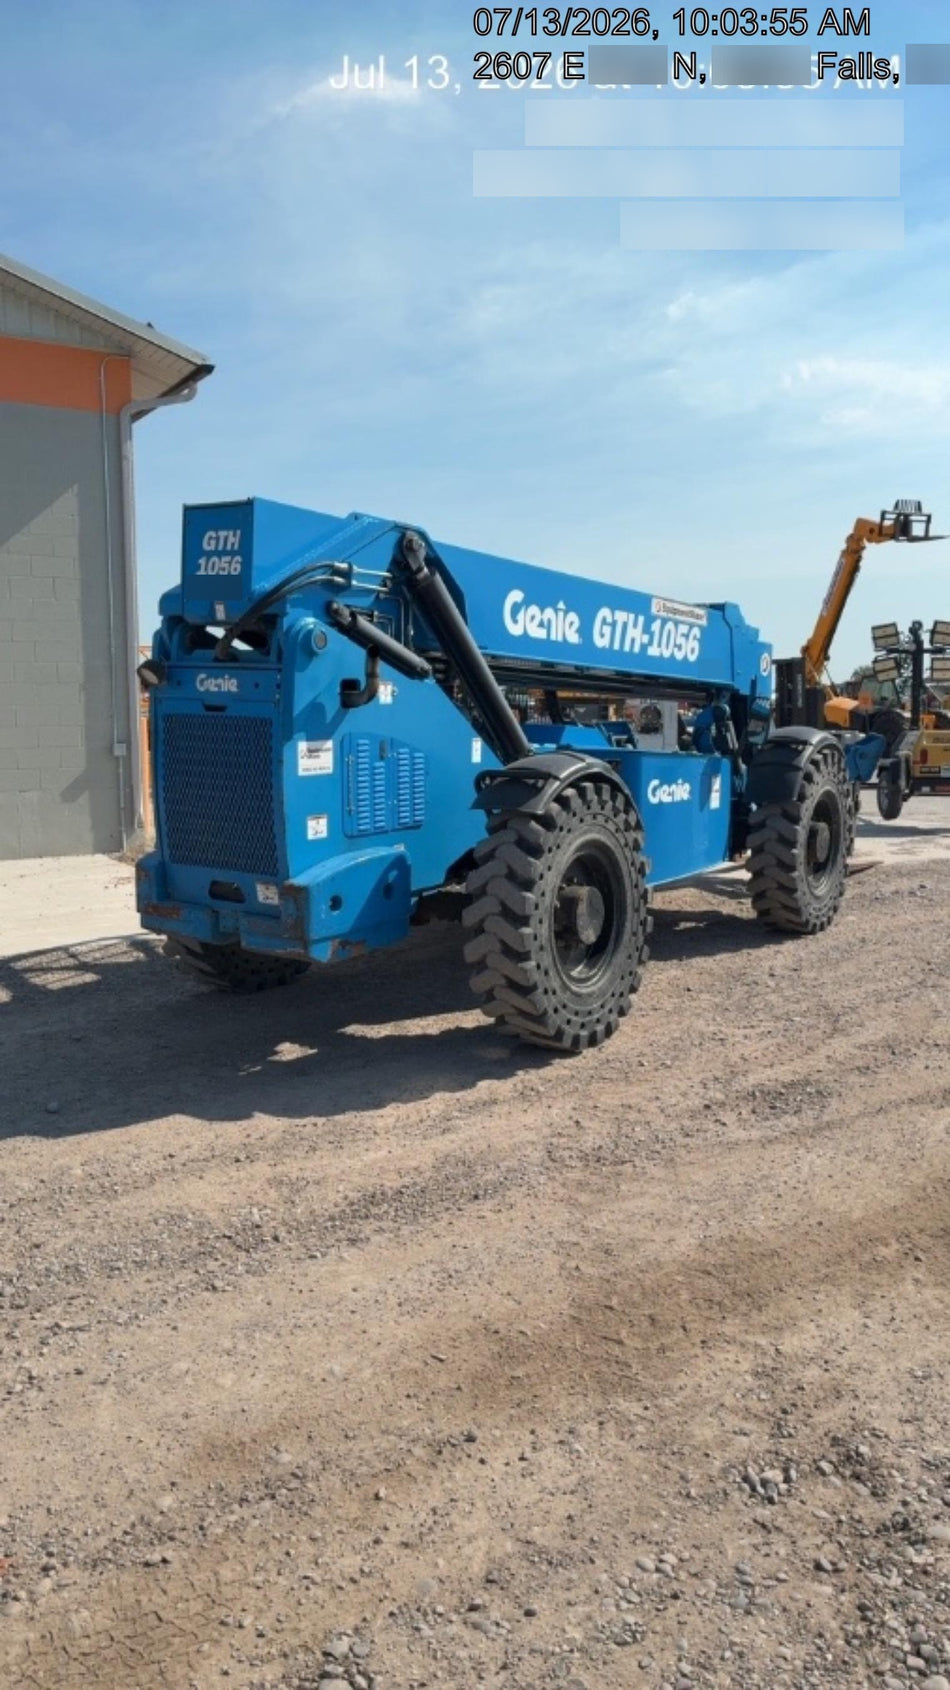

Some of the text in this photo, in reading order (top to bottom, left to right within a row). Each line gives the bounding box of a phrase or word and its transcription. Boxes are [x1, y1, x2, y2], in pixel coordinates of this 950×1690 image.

[203, 530, 241, 551] GTH
[196, 556, 242, 576] 1056
[503, 589, 701, 662] Genie GTH-1056
[196, 673, 239, 692] Genie
[647, 778, 691, 804] Genie
